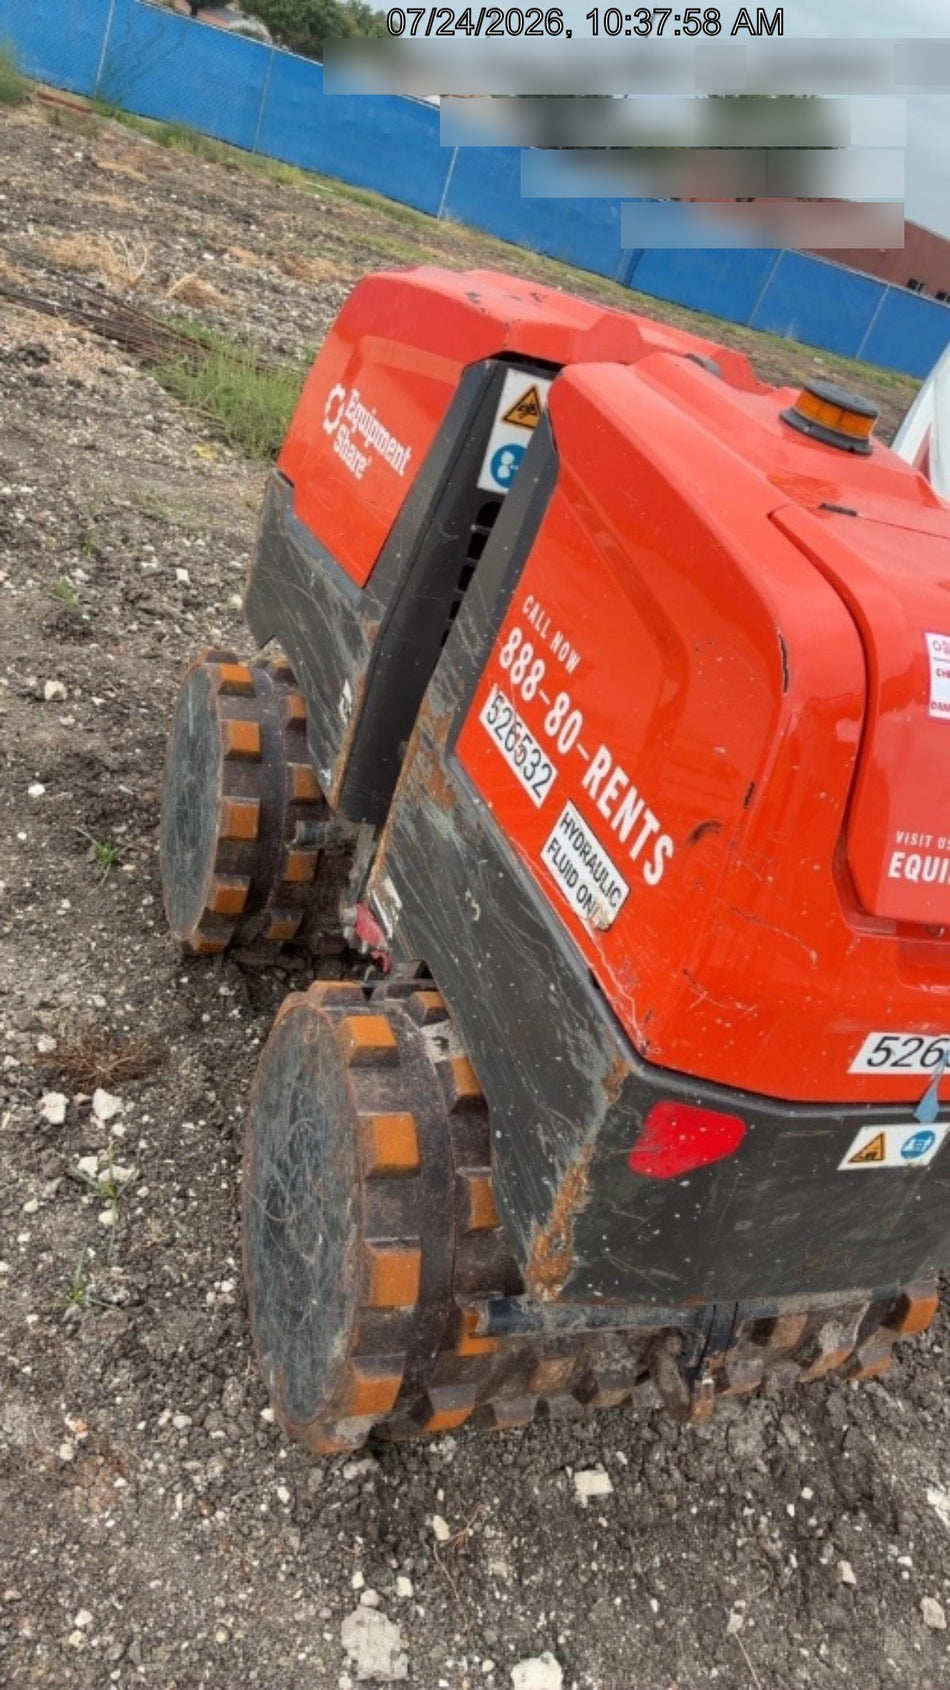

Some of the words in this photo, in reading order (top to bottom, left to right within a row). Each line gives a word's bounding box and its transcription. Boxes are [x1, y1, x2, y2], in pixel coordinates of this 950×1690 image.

[334, 423, 367, 479] Share
[345, 388, 411, 476] Equipment
[522, 594, 551, 639] CALL
[549, 630, 581, 675] NOW
[486, 694, 553, 799] 526532
[499, 627, 674, 886] 888-80-RENTS
[547, 837, 578, 888] FLUID
[560, 811, 622, 907] HYDRAULIC
[888, 851, 950, 885] EQUI
[896, 830, 933, 848] VISIT
[867, 1036, 950, 1067] 526
